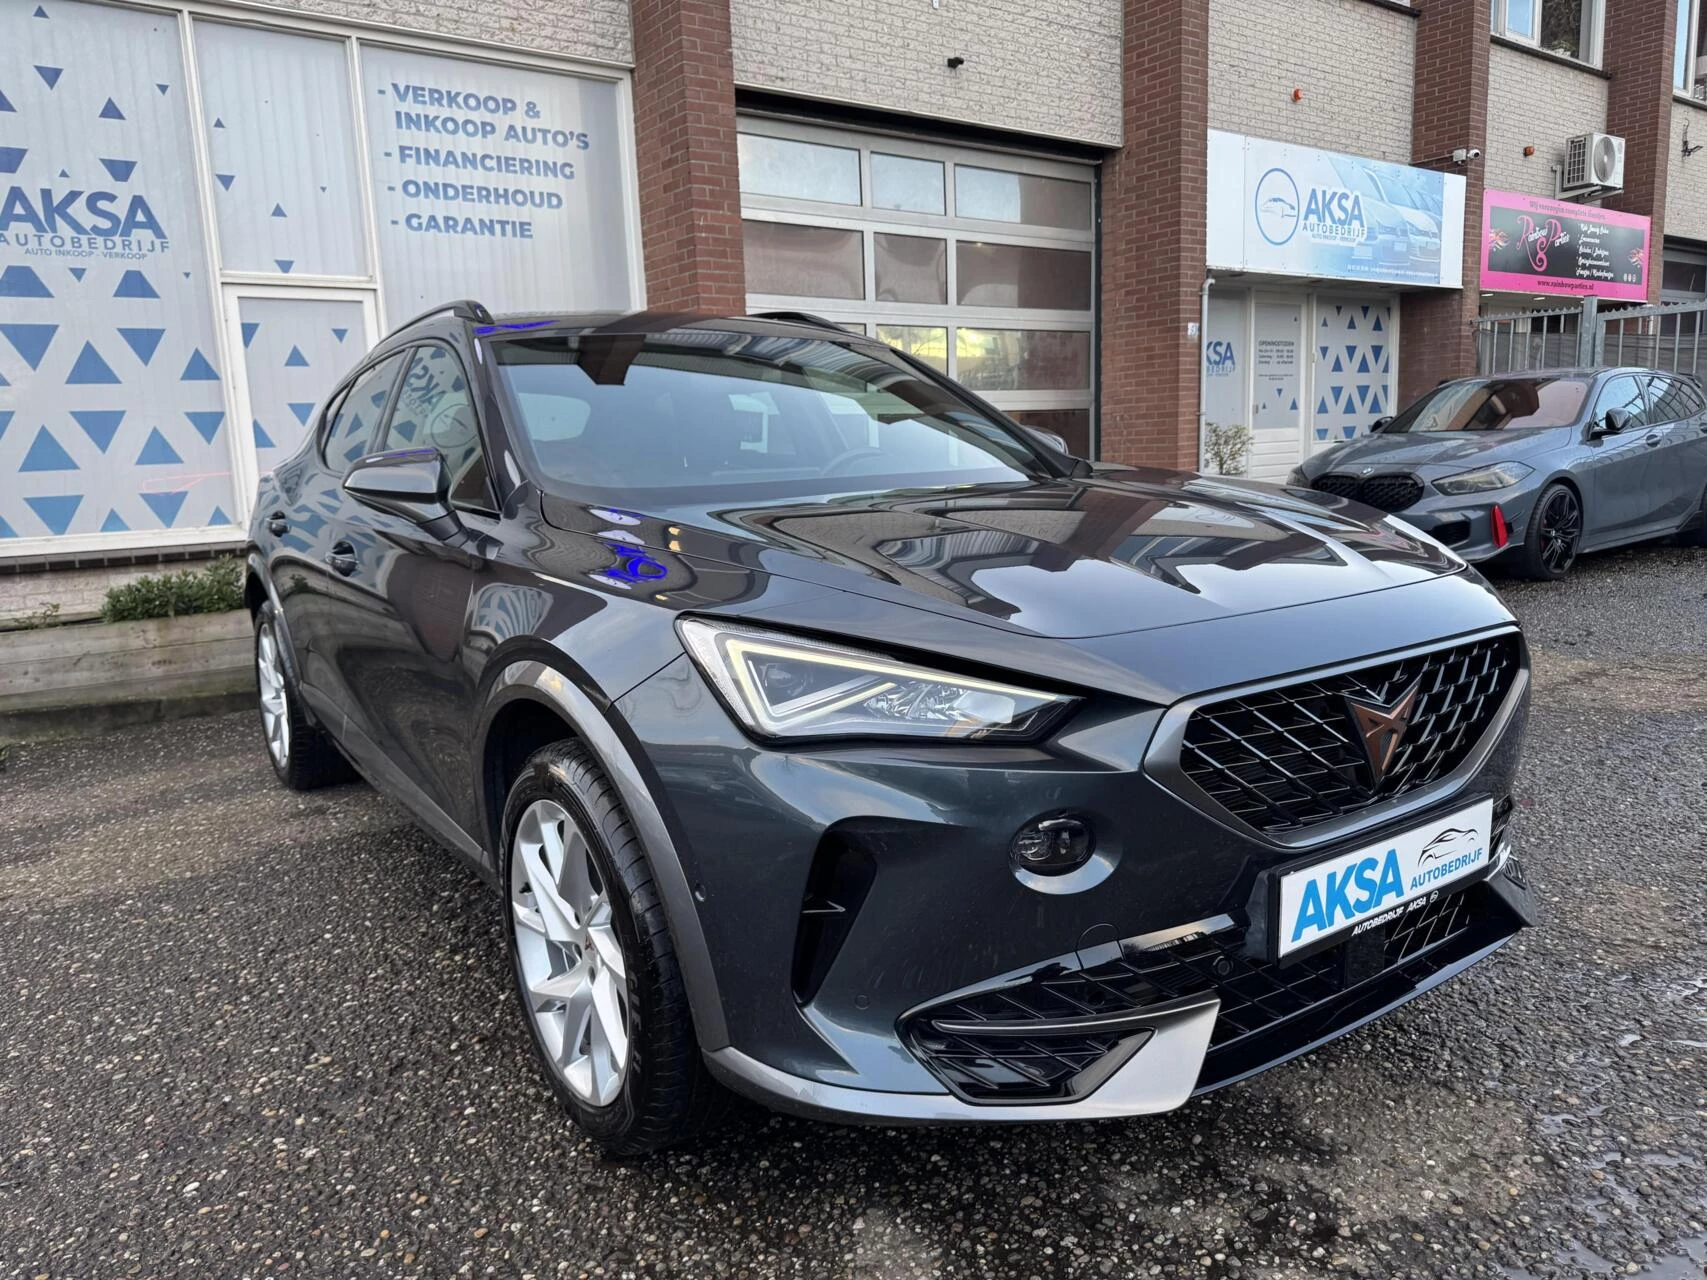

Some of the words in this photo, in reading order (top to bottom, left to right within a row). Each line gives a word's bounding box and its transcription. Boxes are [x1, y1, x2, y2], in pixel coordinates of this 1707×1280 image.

[391, 83, 517, 116] VERKOOP
[524, 101, 541, 119] &
[395, 110, 497, 139] INKOOP
[504, 124, 590, 150] AUTO'S
[398, 145, 575, 180] FINANCIERING
[402, 179, 563, 210] ONDERHOUD
[1303, 188, 1365, 228] AKSA
[0, 186, 168, 240] AKSA
[405, 213, 534, 239] GARANTIE
[1302, 220, 1366, 238] AUTOBEDRIJF
[0, 233, 170, 253] AUTOBEDRIJF
[25, 248, 51, 256] AUTO
[55, 249, 94, 258] INKOOP
[102, 252, 148, 260] VERKOOP
[1537, 279, 1594, 291] www.rainbowparties.nl
[1291, 848, 1404, 943] AKSA
[1410, 847, 1483, 890] AUTOBEDRIJF
[1351, 906, 1405, 936] AUTOBEDRIJF
[1406, 896, 1427, 913] AKSA
